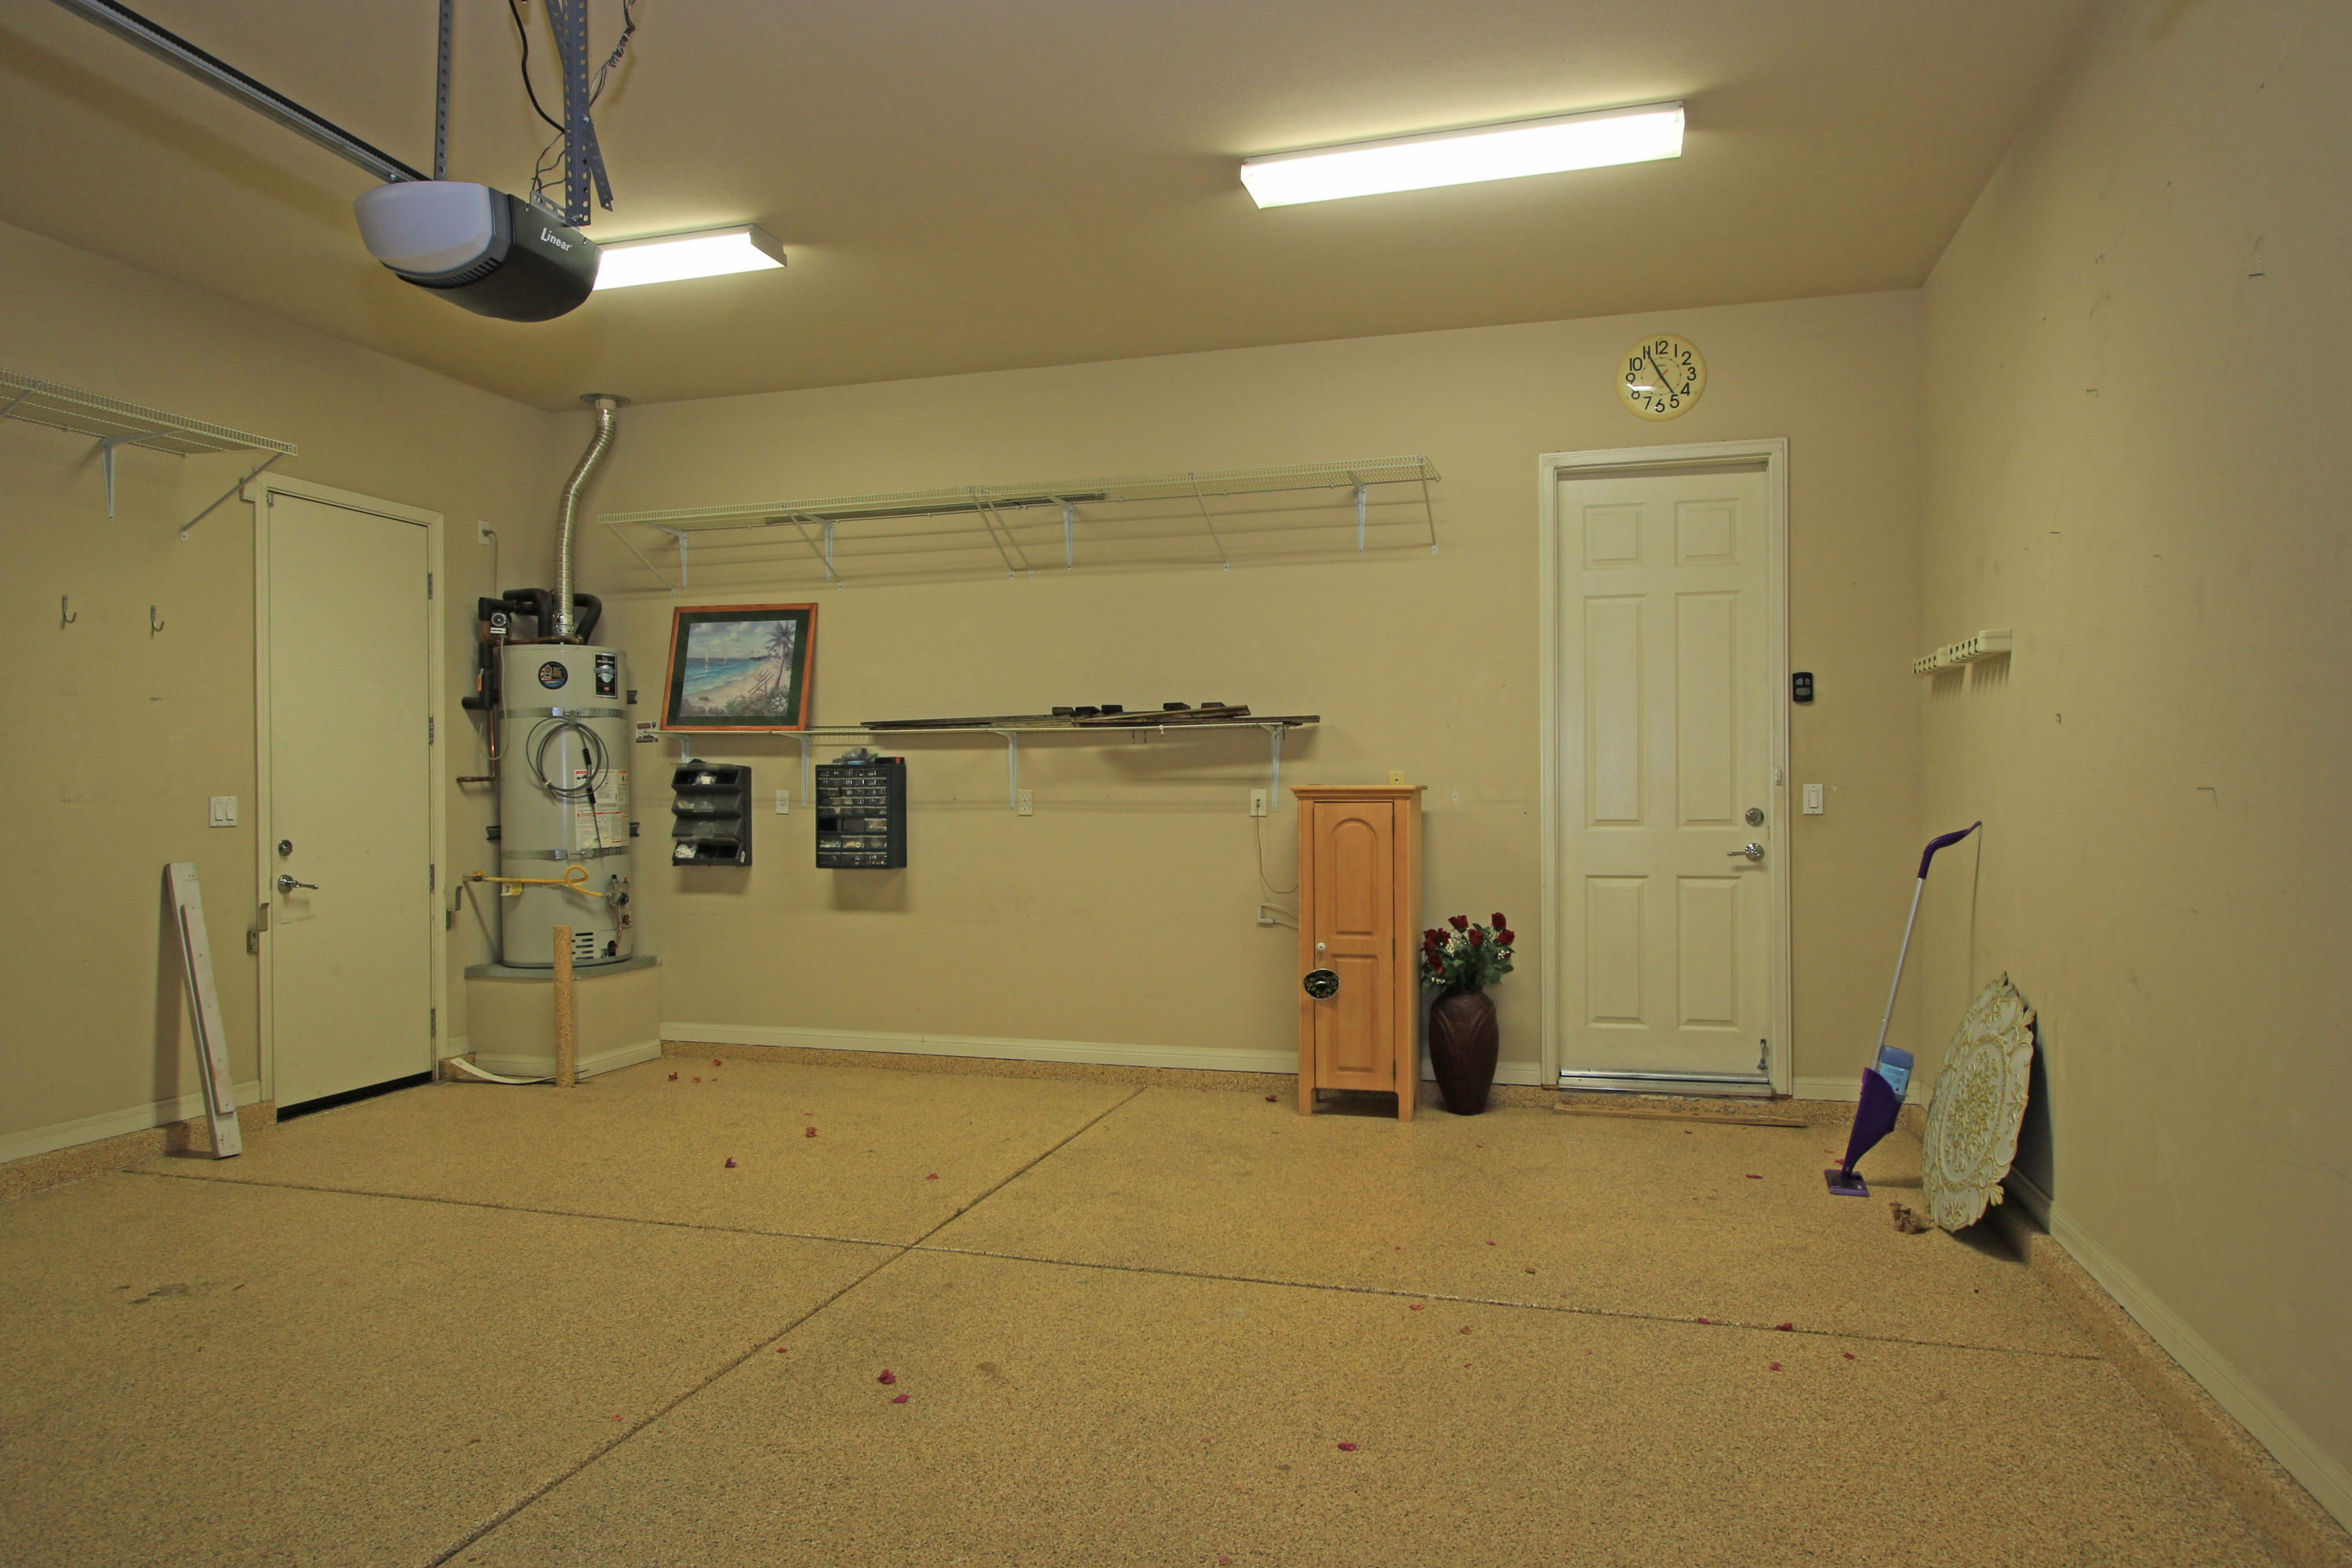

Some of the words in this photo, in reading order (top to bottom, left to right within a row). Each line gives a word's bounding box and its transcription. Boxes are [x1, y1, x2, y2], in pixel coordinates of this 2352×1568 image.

[540, 227, 571, 252] Linear
[1655, 340, 1668, 355] 12
[1675, 343, 1678, 358] 1
[1629, 358, 1642, 372] 10
[1682, 351, 1691, 365] 2
[1625, 372, 1635, 386] 9
[1687, 367, 1697, 381] 3
[1680, 382, 1690, 396] 4
[1643, 396, 1652, 410] 7
[1654, 398, 1665, 413] 6
[1669, 394, 1679, 408] 5
